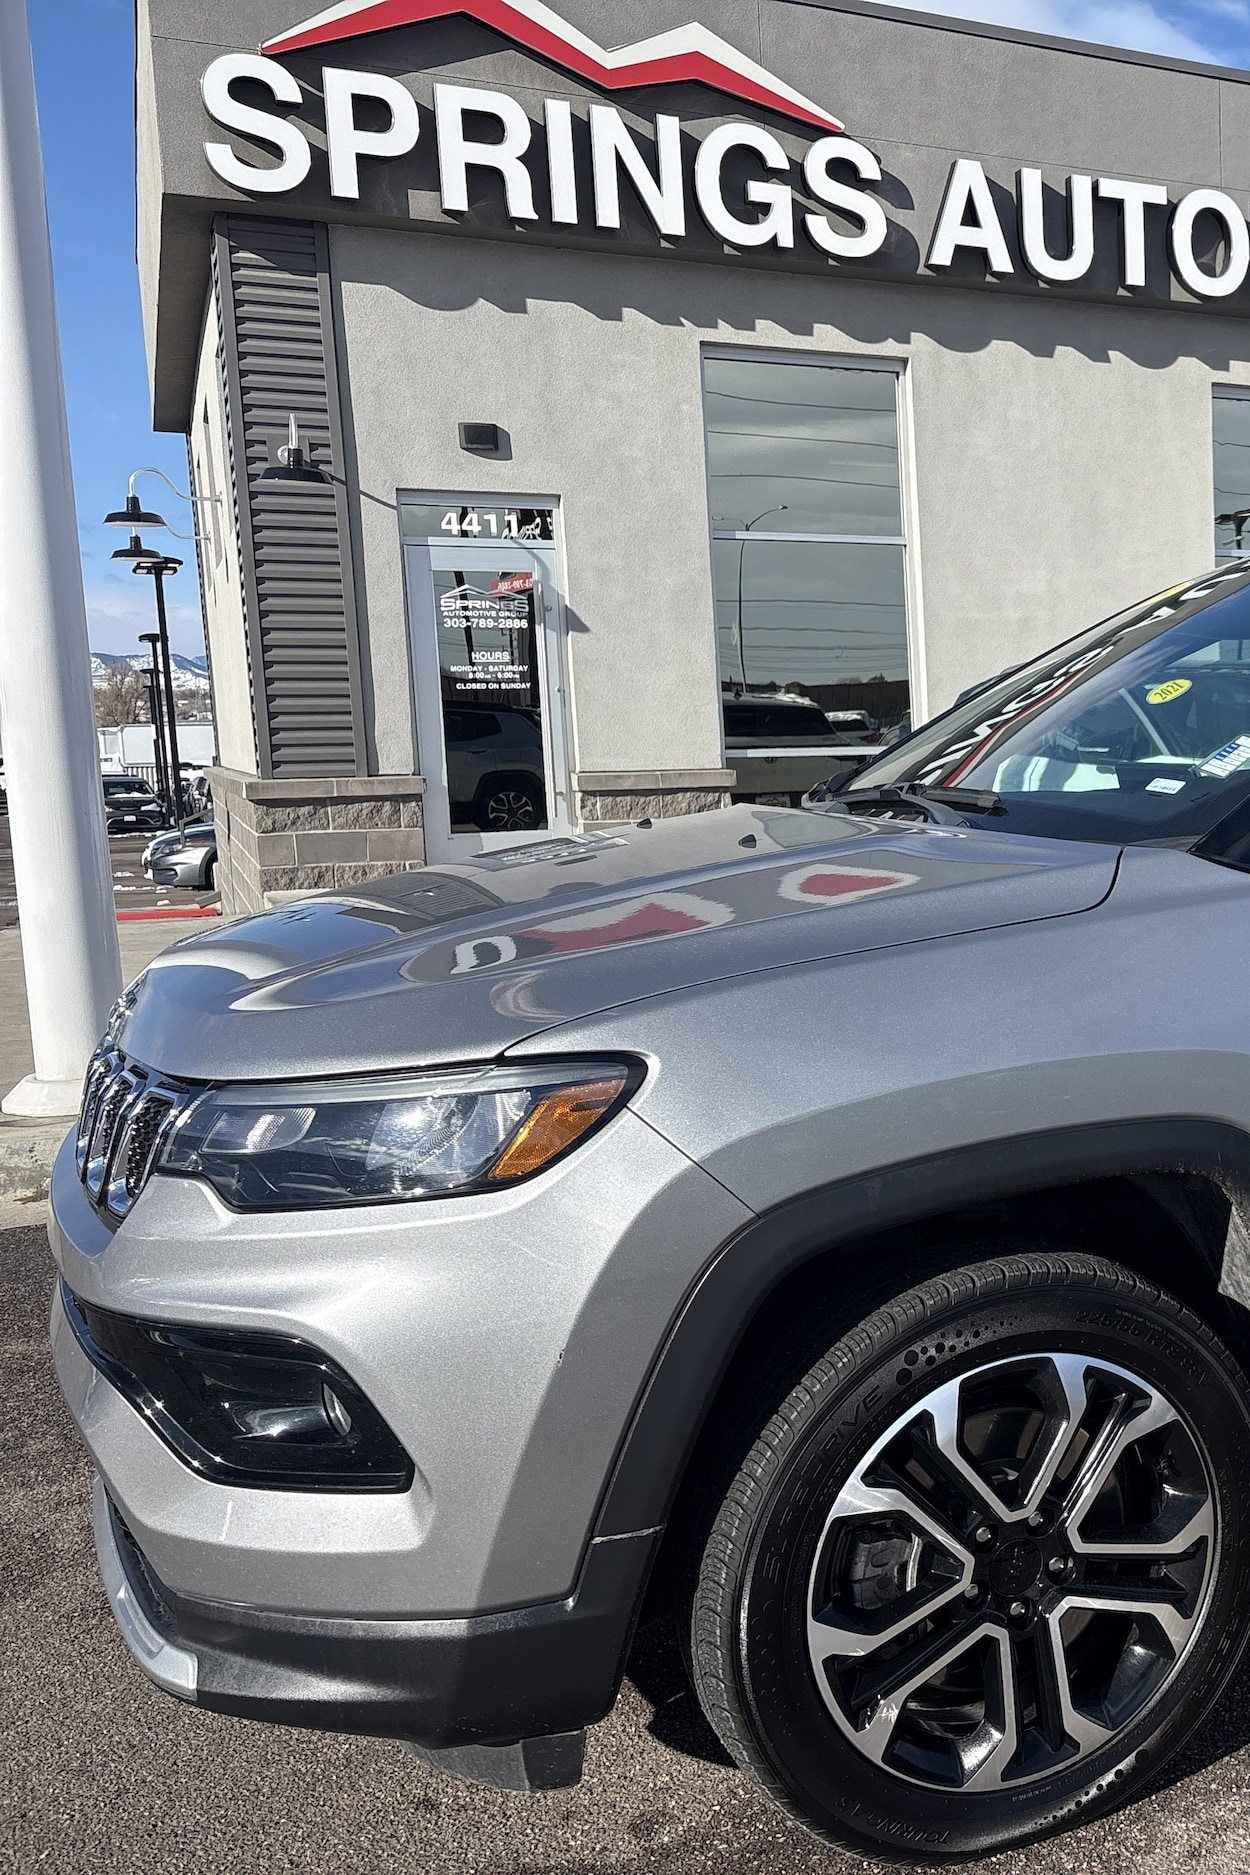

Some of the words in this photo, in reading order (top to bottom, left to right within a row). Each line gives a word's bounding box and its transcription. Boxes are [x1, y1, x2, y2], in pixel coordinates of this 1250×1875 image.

[200, 52, 889, 259] SPRINGS
[440, 512, 520, 537] 4411
[440, 599, 530, 612] SPRINGS
[442, 610, 497, 618] AUTOMOTIVE
[498, 610, 529, 618] GROUP
[443, 618, 529, 629] 303-789-2886
[471, 651, 510, 660] HOURS
[1153, 681, 1184, 700] 2021
